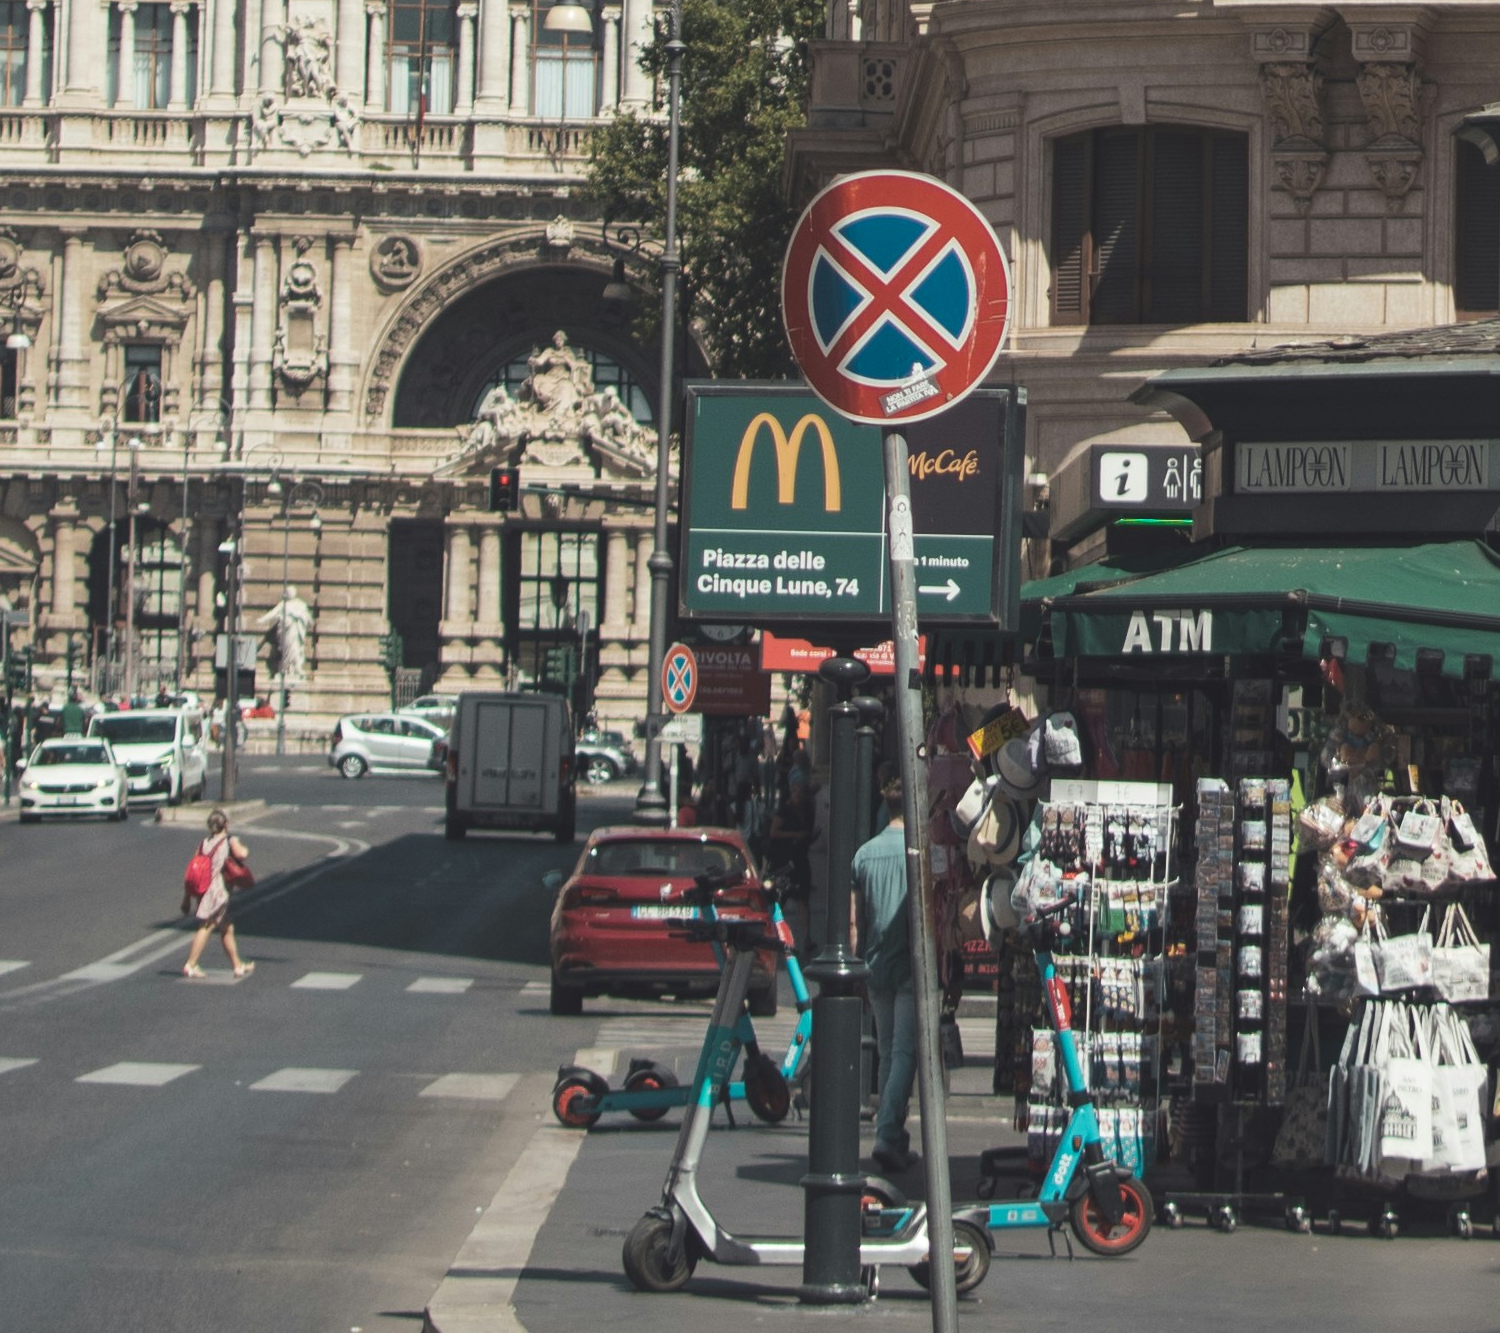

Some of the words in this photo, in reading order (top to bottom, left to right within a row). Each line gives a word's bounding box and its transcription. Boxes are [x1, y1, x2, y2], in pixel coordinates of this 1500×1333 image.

[908, 449, 979, 481] McCafé
[1246, 446, 1347, 488] LAMPOON
[1382, 444, 1484, 486] LAMPOON
[703, 549, 769, 569] Piazza
[774, 550, 826, 570] delle
[921, 555, 927, 566] 1
[928, 555, 969, 568] minuto
[697, 574, 772, 598] Cinque
[777, 576, 832, 598] Lune,
[836, 578, 859, 596] 74
[1122, 609, 1213, 653] ATM
[694, 652, 751, 665] RIVOLTA
[710, 1040, 731, 1094] BIRD
[1054, 1153, 1073, 1185] dott
